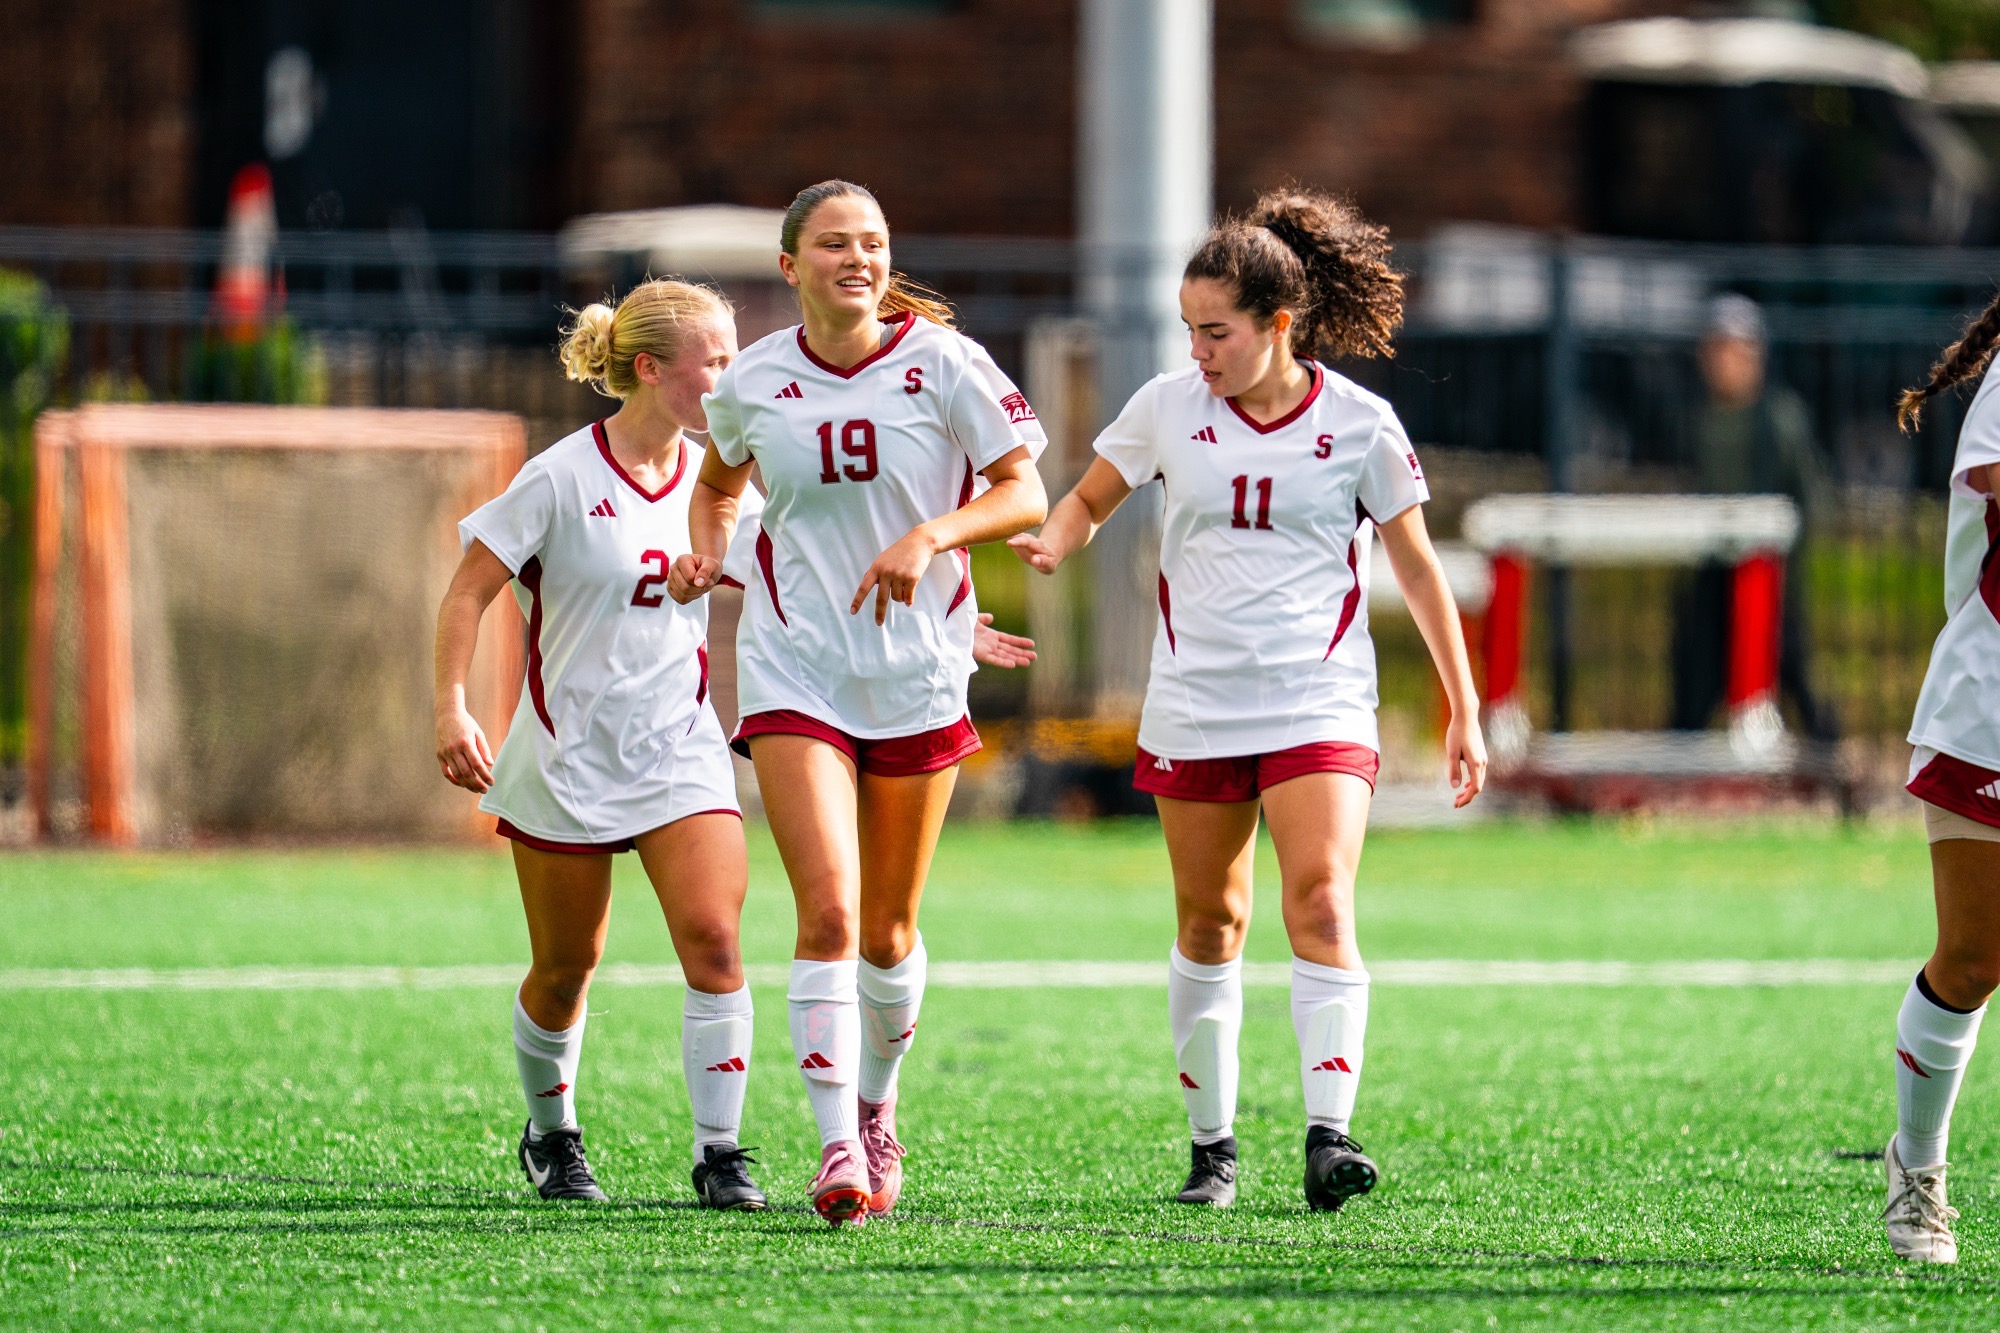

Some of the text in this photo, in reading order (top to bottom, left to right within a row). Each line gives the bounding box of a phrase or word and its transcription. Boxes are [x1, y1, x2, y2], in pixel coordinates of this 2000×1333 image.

[903, 367, 923, 394] S
[816, 418, 879, 484] 19
[1314, 434, 1333, 459] S
[1231, 474, 1273, 530] 11
[630, 549, 669, 608] 2
